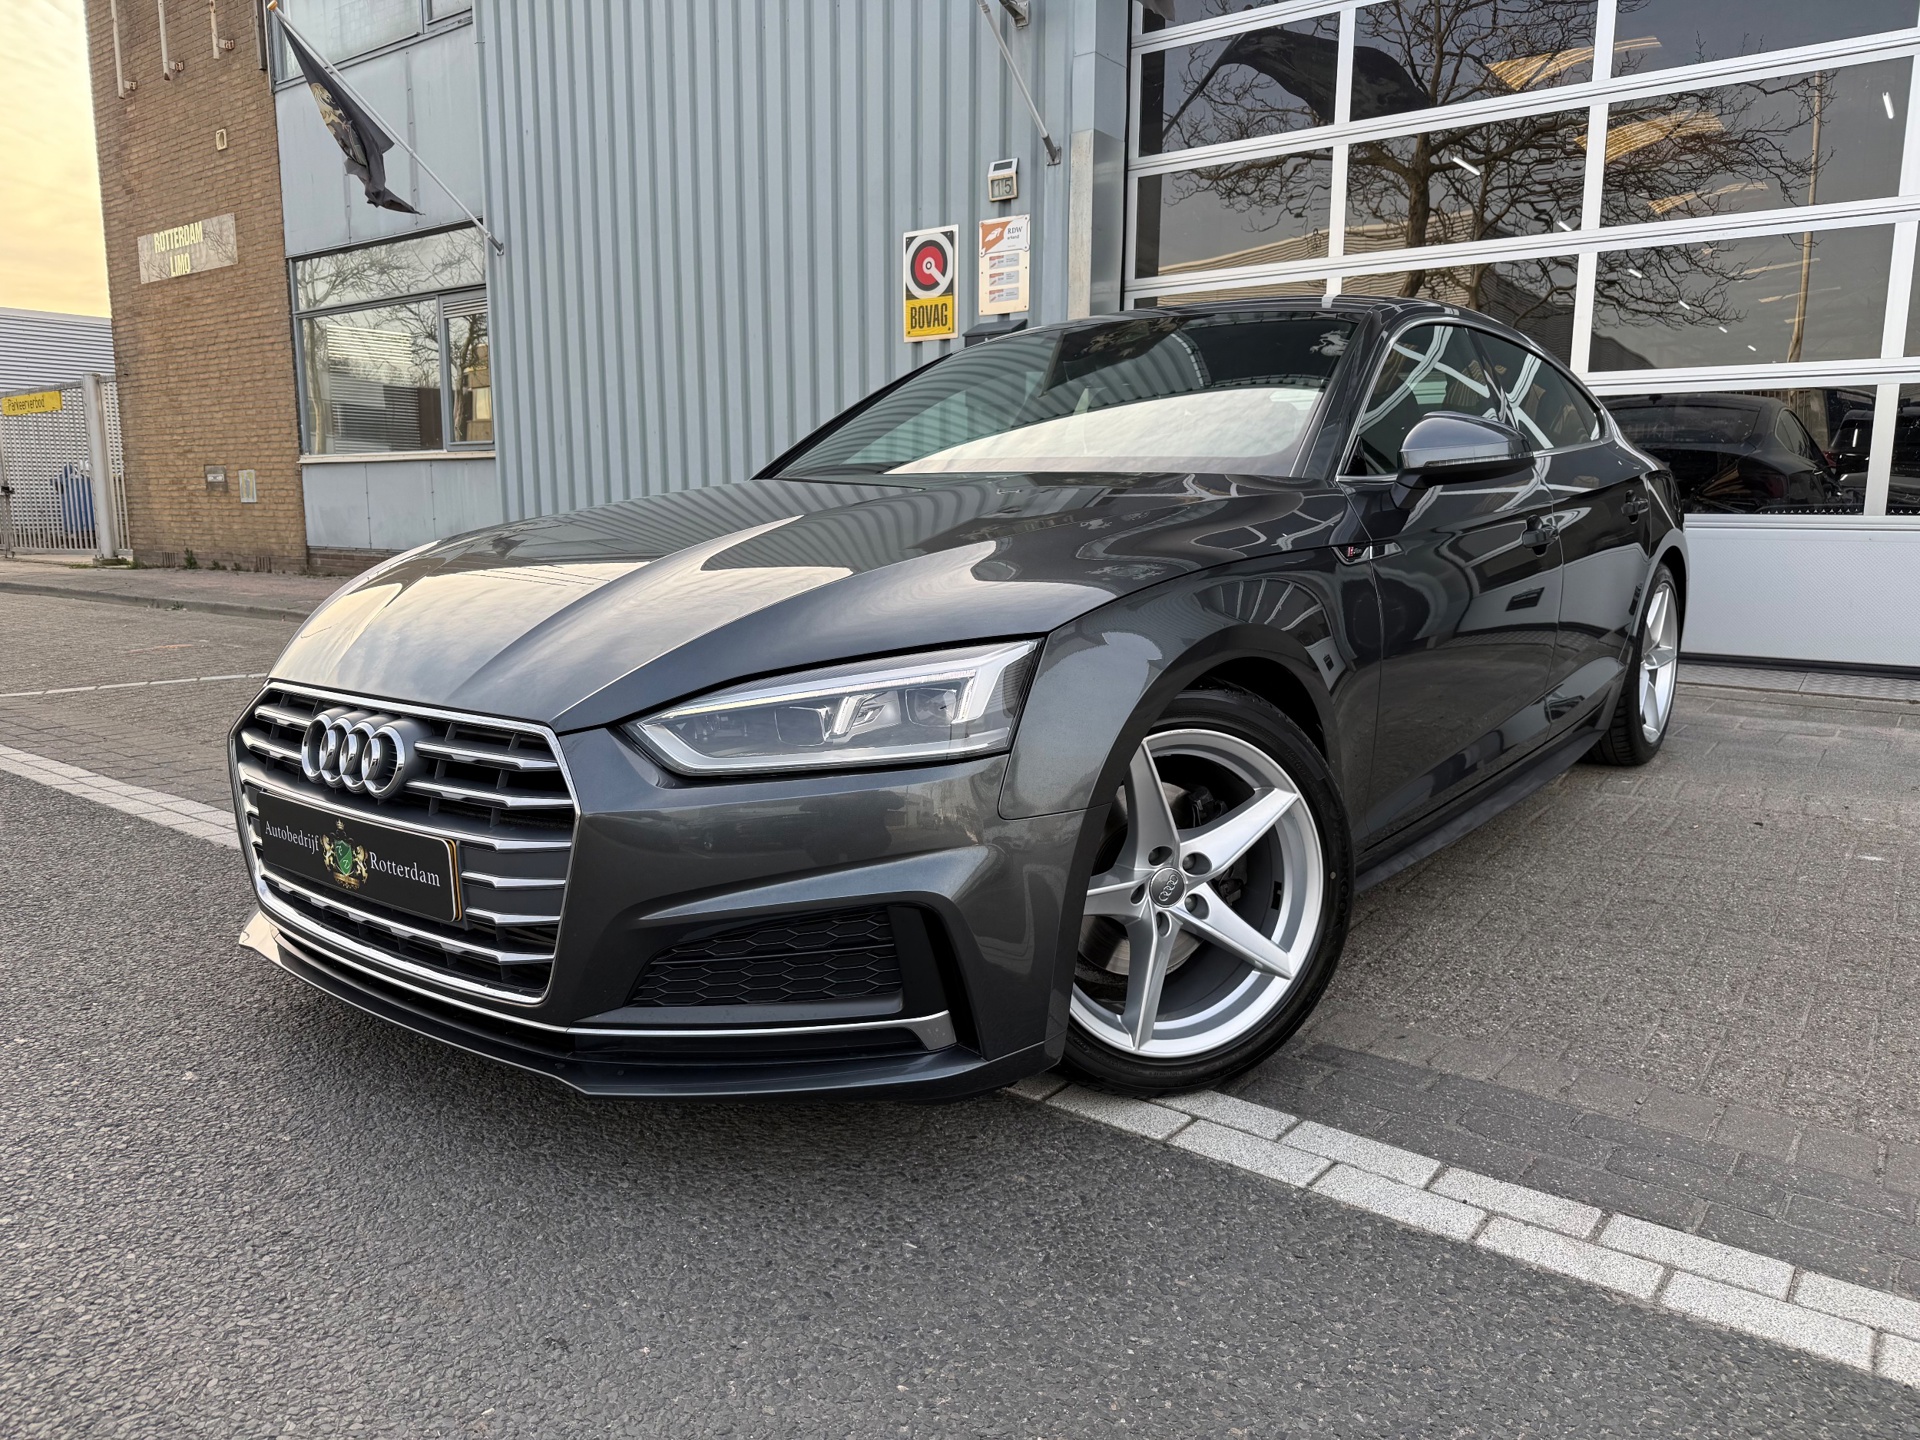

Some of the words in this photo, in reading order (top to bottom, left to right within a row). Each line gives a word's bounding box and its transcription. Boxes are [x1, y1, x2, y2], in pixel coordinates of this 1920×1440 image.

[995, 179, 1011, 196] 15
[153, 221, 203, 254] ROTTERDAM
[1007, 226, 1023, 234] RDW
[169, 253, 191, 277] LIMO
[910, 302, 948, 330] BOVAG
[7, 395, 45, 412] Parkeerverbod
[265, 821, 320, 855] Autobedrijf
[369, 851, 441, 887] Rotterdam
